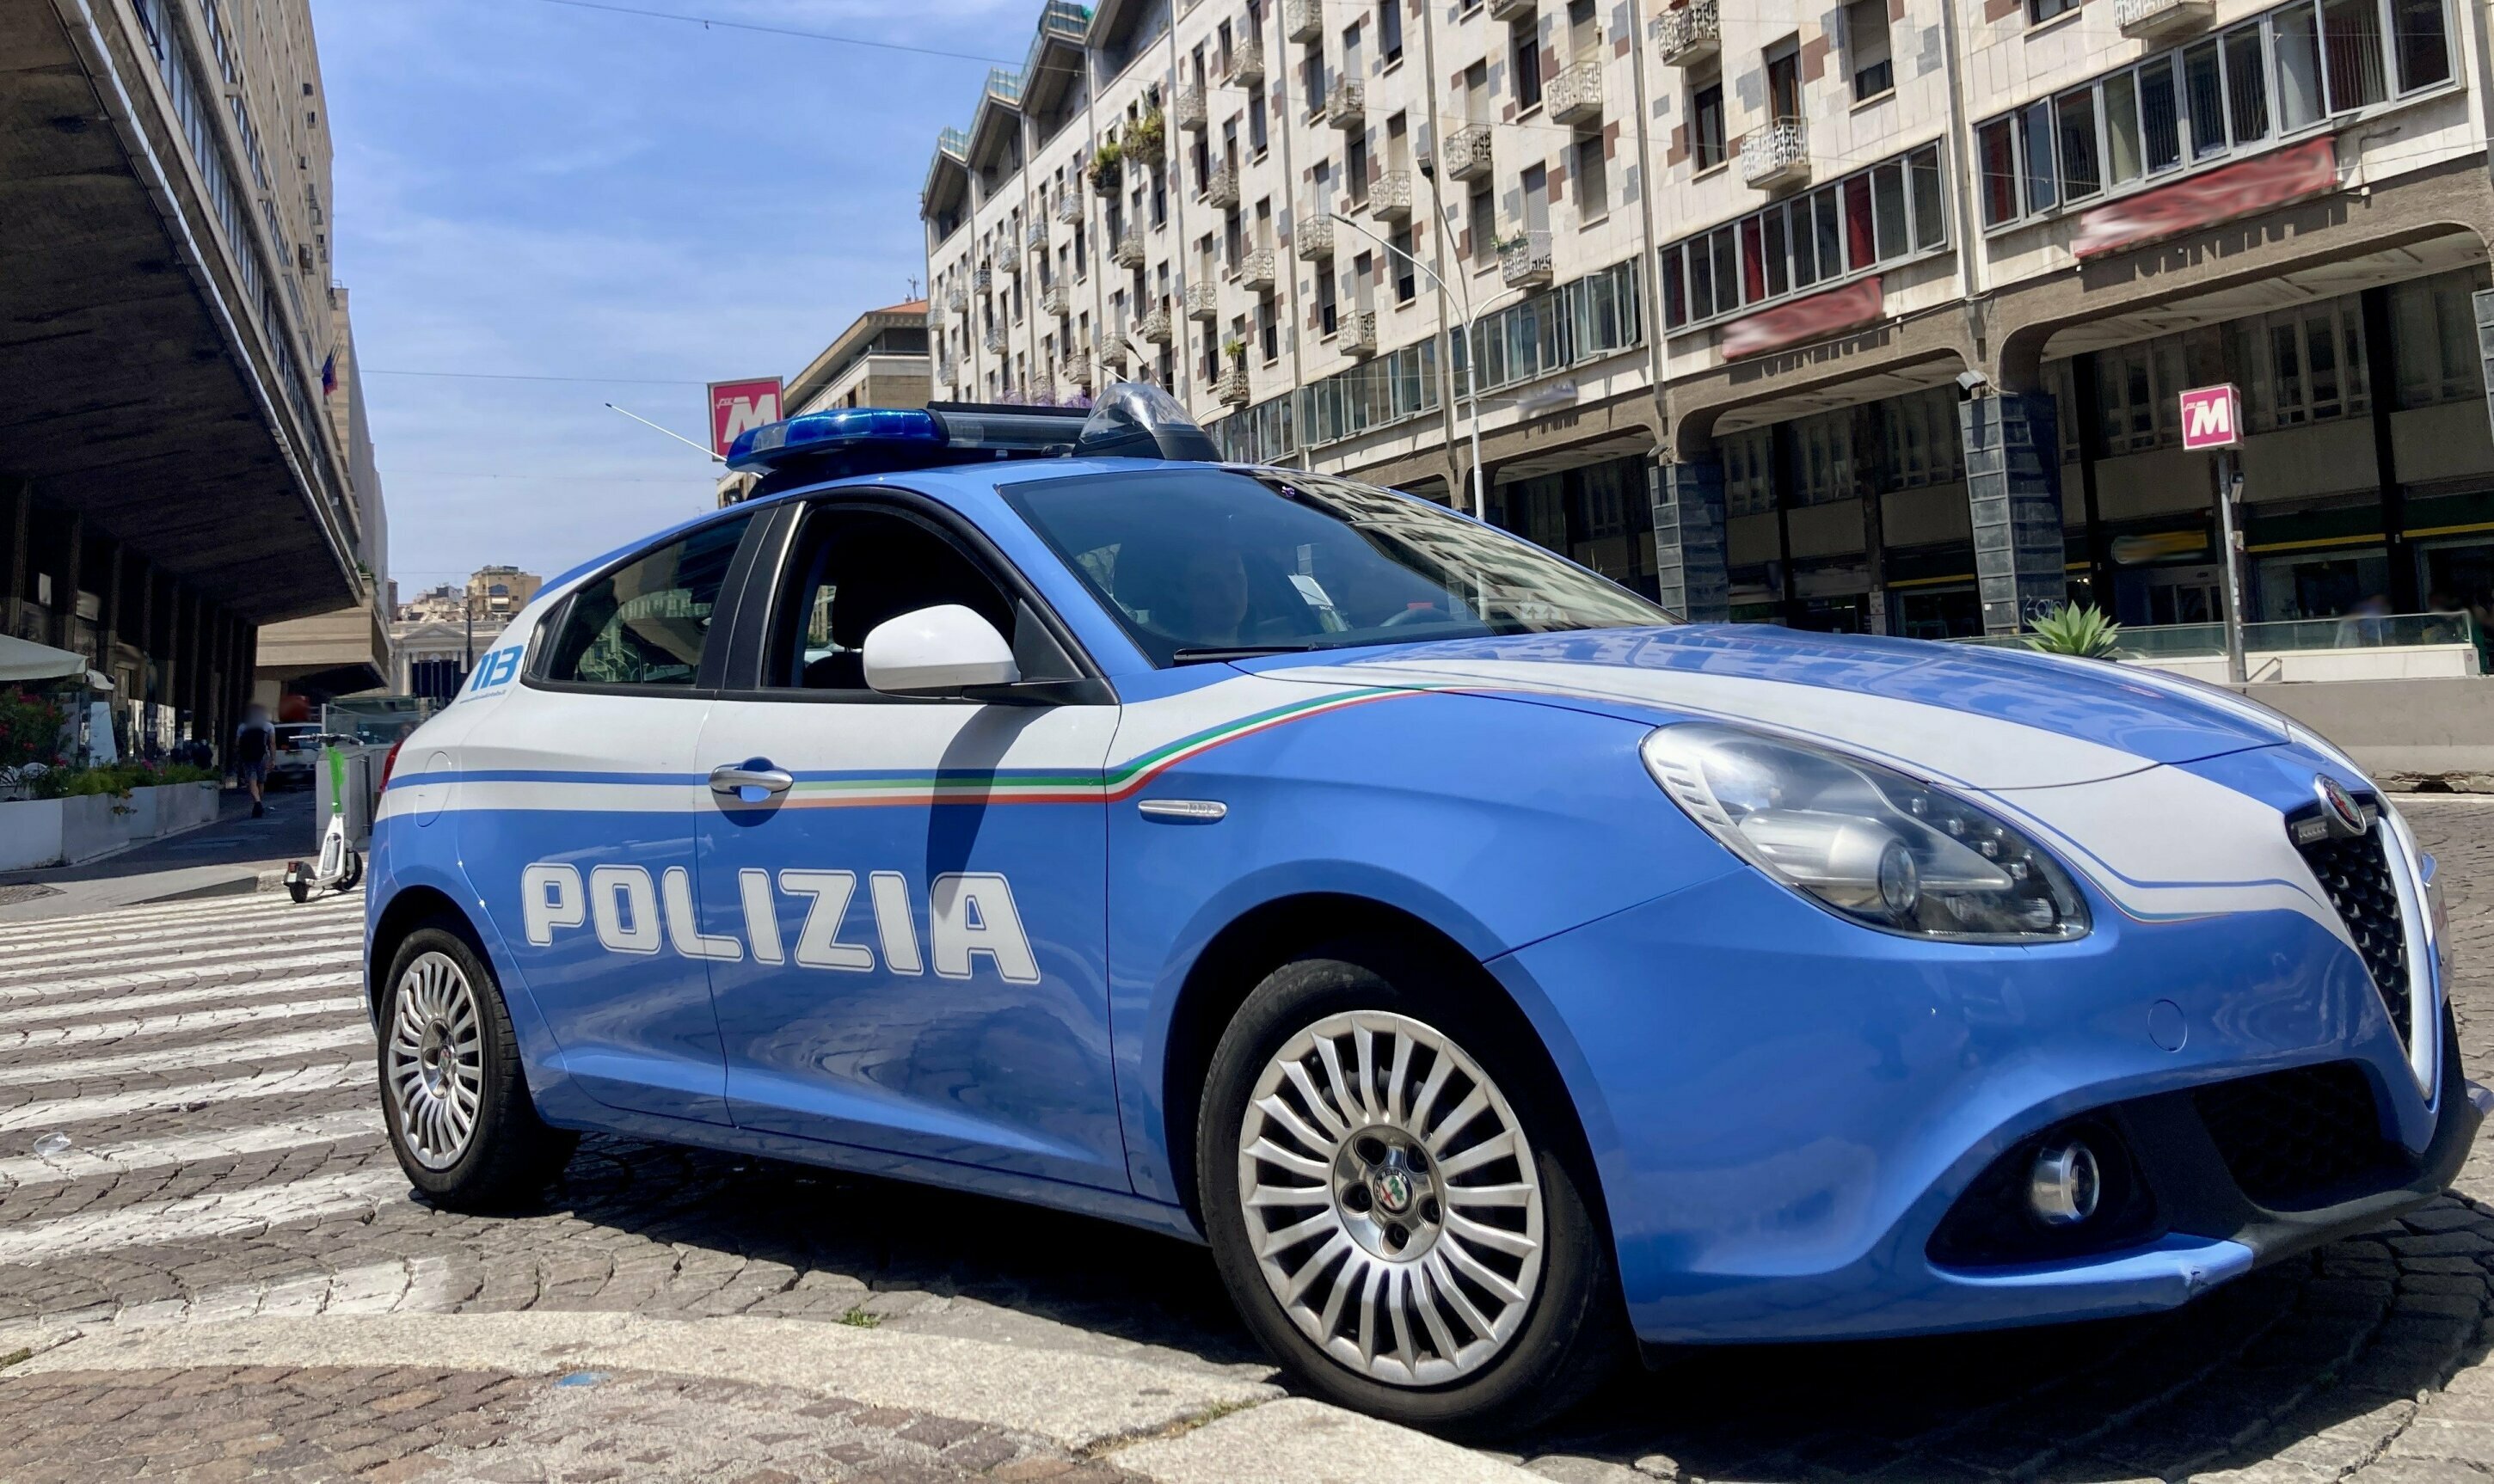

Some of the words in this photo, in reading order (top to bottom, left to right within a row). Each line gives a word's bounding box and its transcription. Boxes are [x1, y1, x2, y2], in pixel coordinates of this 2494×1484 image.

[723, 394, 777, 443] M
[2190, 396, 2229, 438] M
[470, 645, 524, 692] 113
[521, 862, 1041, 985] POLIZIA
